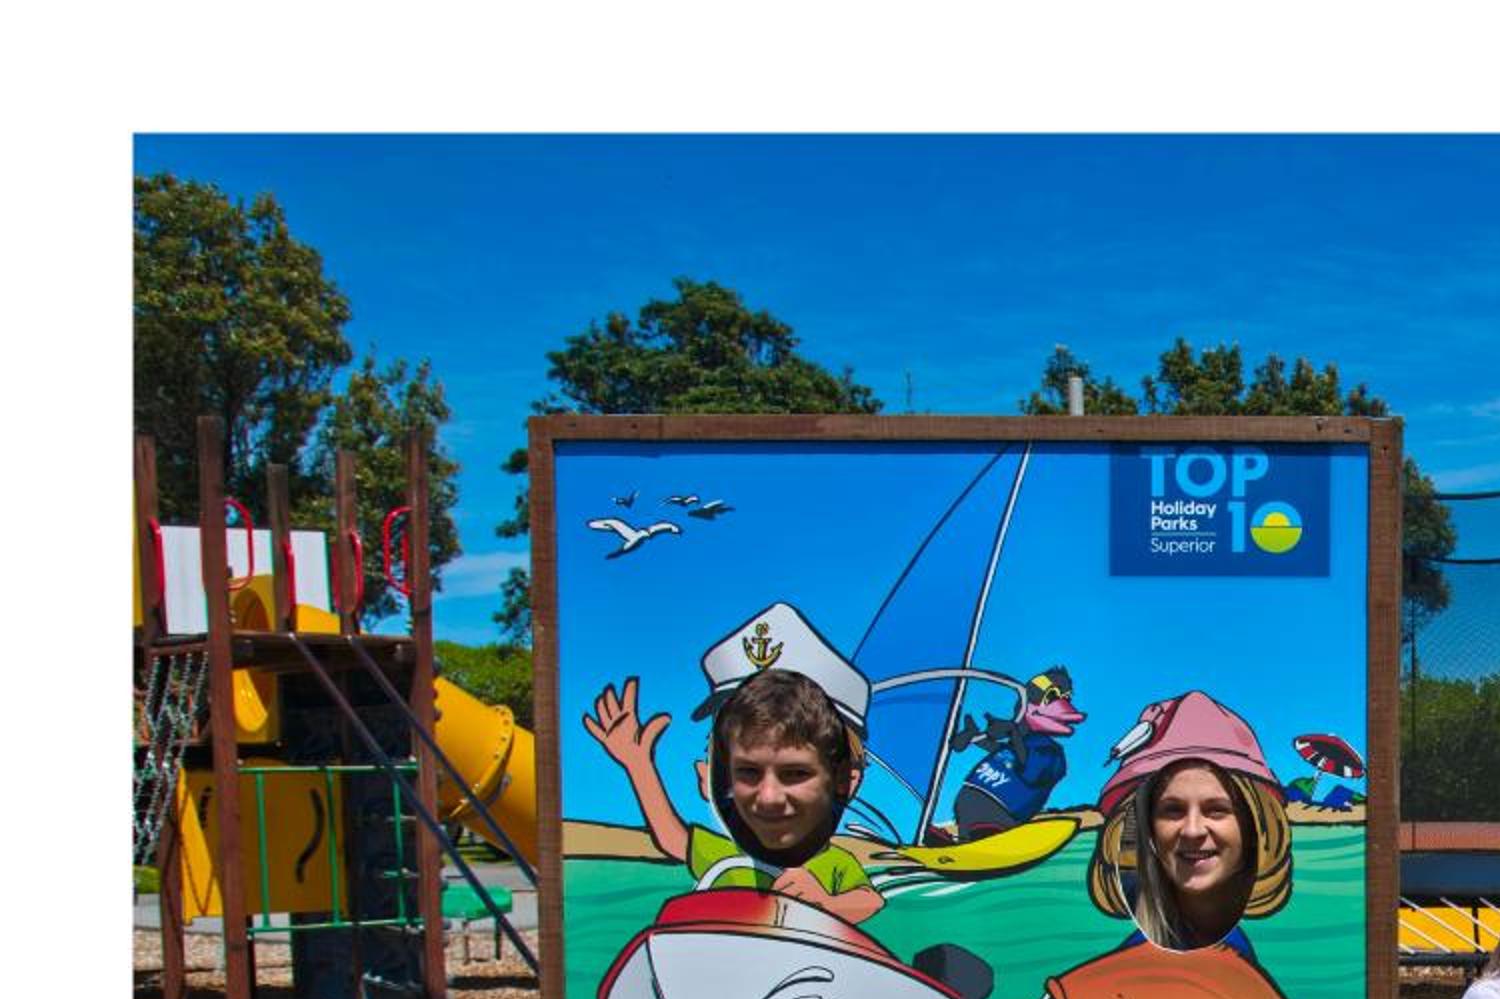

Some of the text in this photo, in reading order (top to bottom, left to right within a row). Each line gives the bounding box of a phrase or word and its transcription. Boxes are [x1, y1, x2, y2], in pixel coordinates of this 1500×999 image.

[1139, 446, 1269, 498] TOP
[1151, 500, 1217, 518] Holiday
[1151, 517, 1198, 531] Parks
[1151, 537, 1216, 556] Superior
